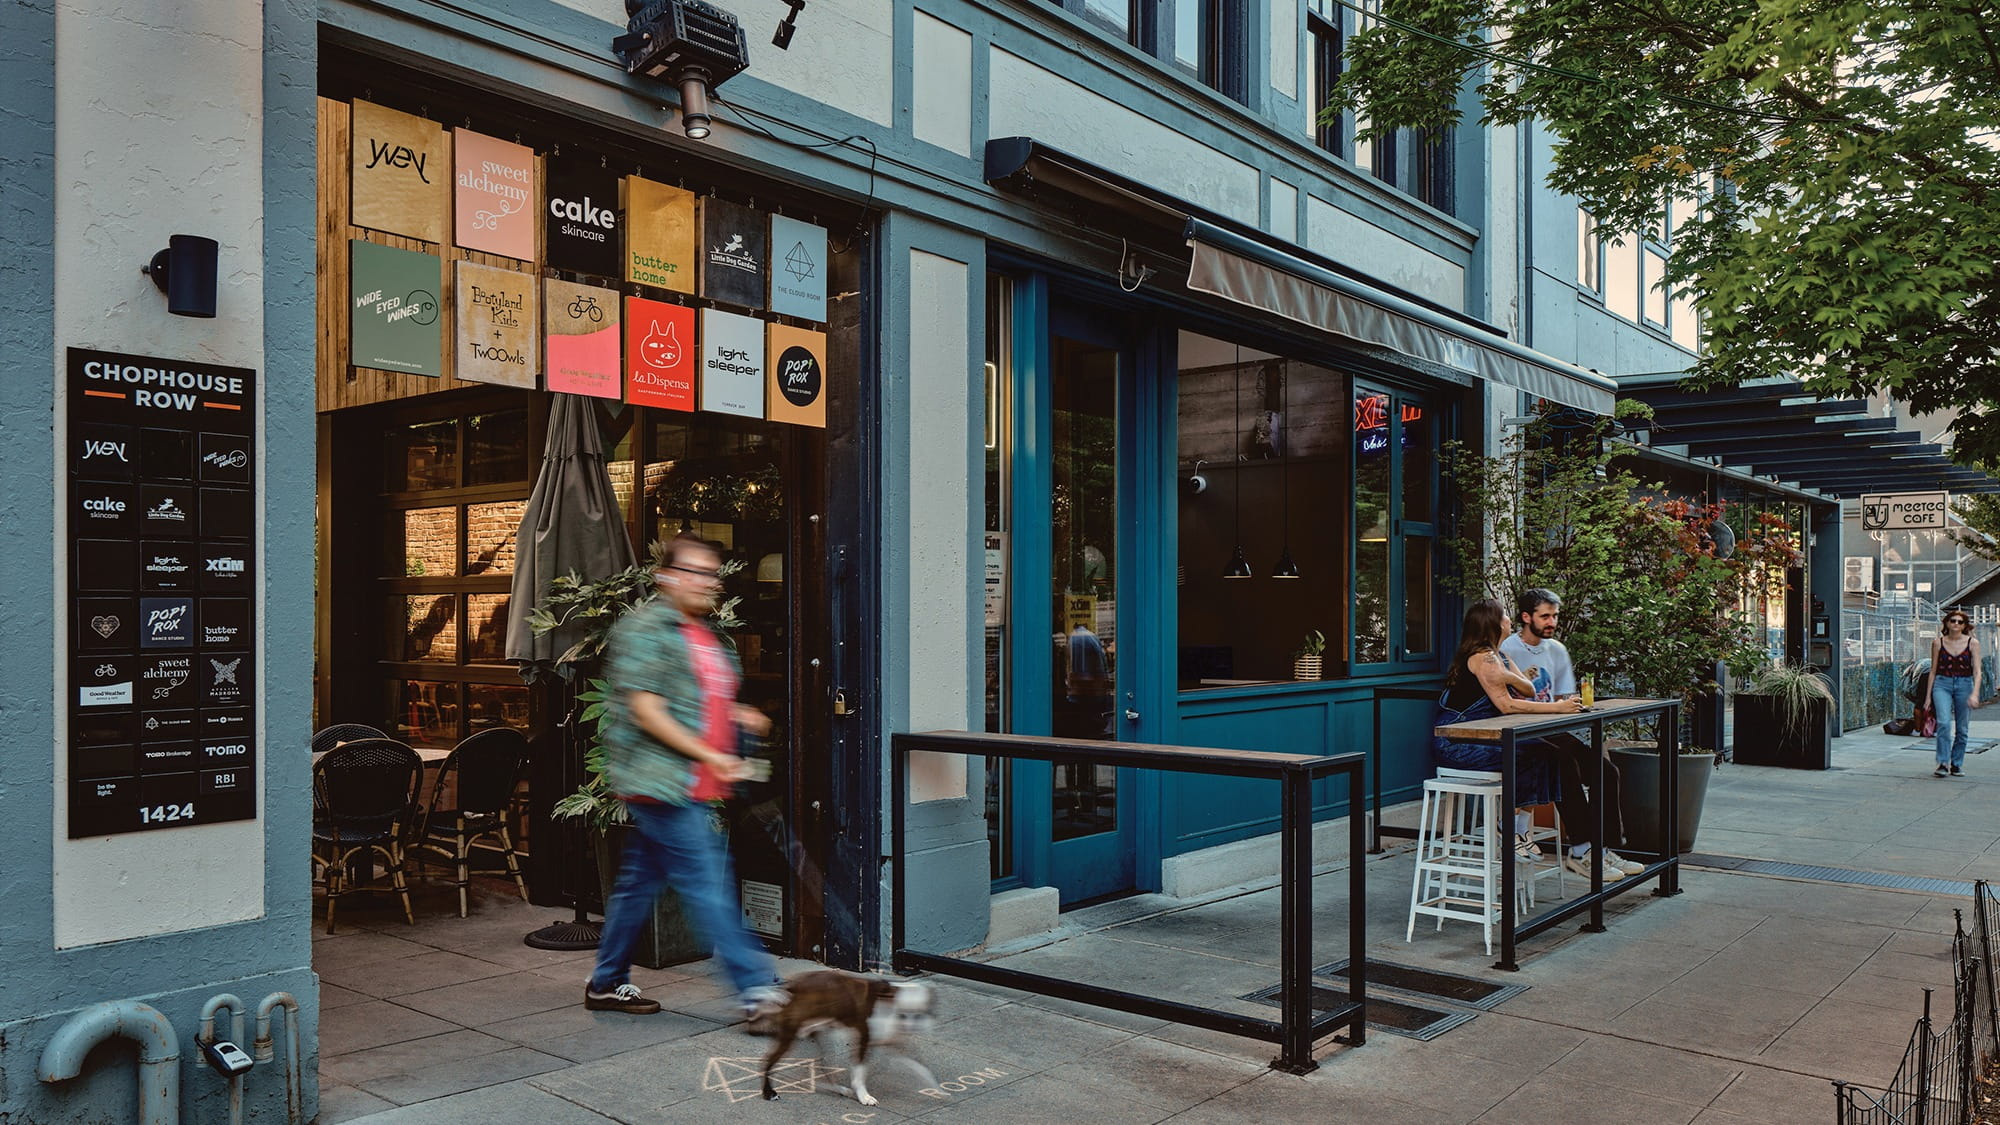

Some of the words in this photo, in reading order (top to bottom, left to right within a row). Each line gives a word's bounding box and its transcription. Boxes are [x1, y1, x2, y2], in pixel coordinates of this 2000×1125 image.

[481, 159, 529, 184] sweet
[458, 172, 528, 201] alchemy
[550, 196, 615, 230] cake
[561, 223, 605, 242] skincare
[632, 252, 678, 274] butter
[711, 254, 725, 262] Little
[726, 256, 736, 266] Dog
[738, 259, 756, 270] Garden
[632, 268, 666, 286] home
[356, 290, 382, 308] WIDE
[472, 286, 523, 310] Bootyland
[778, 286, 788, 294] THE
[788, 288, 806, 298] CLOUD
[806, 292, 820, 302] ROOM
[376, 296, 400, 314] EYED
[387, 303, 420, 323] WINES
[491, 306, 518, 328] Kids
[718, 346, 750, 362] light
[708, 359, 760, 376] sleeper
[84, 362, 242, 394] CHOPHOUSE
[647, 372, 690, 390] Dispensa
[788, 372, 808, 386] ROX
[135, 390, 197, 411] ROW
[83, 497, 126, 512] cake
[90, 511, 119, 520] skincare
[146, 564, 188, 573] sleeper
[154, 556, 180, 565] light
[152, 619, 180, 636] ROX
[204, 626, 238, 634] butter
[204, 634, 230, 642] home
[158, 658, 190, 668] sweet
[144, 668, 190, 680] alchemy
[205, 744, 246, 756] TOMO
[216, 774, 235, 784] RBI
[140, 802, 196, 824] 1424
